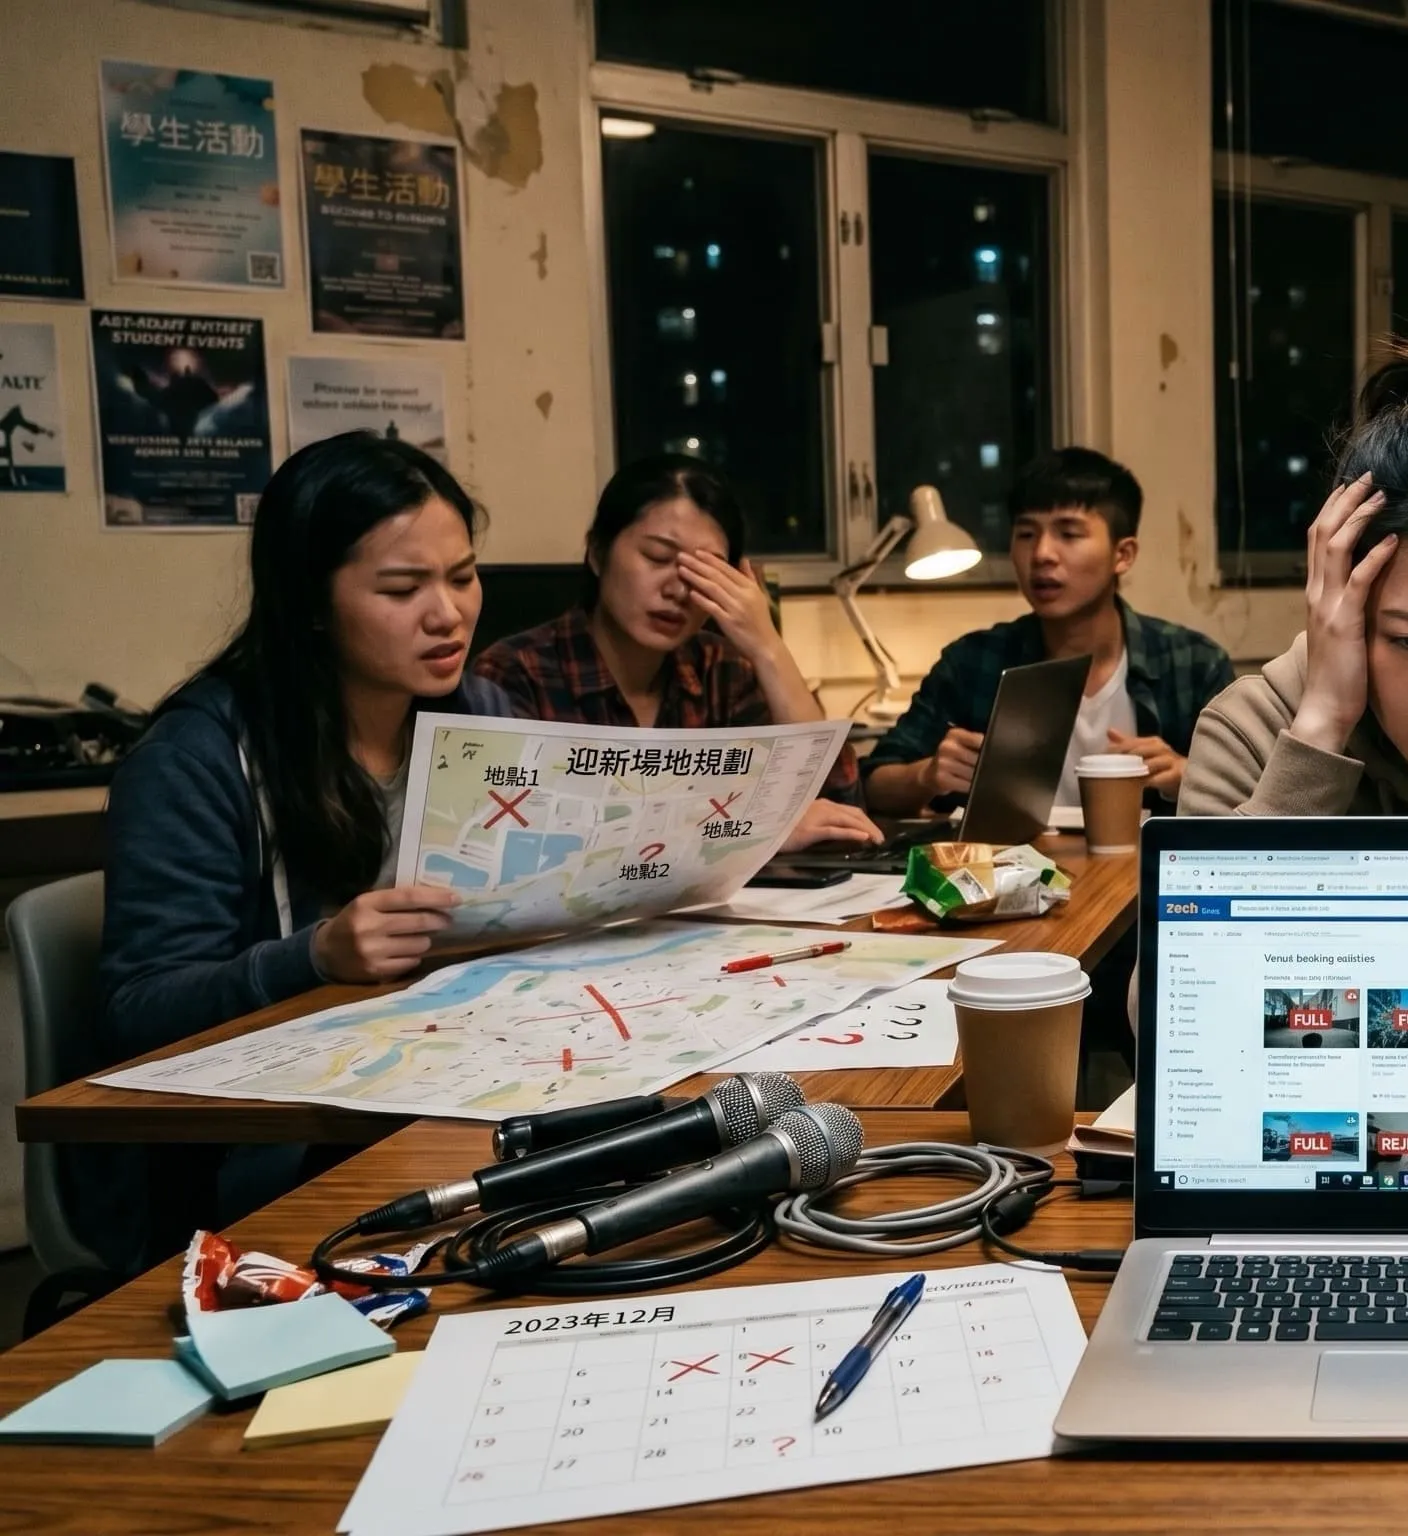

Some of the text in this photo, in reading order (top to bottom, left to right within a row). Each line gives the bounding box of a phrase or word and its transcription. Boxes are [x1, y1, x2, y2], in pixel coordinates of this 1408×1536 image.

[120, 111, 264, 159] 學生活動
[314, 163, 450, 210] 學生活動
[112, 331, 245, 350] STUDENT EVENTS
[484, 765, 540, 787] 地點1
[565, 747, 754, 777] 迎新場地規劃
[703, 820, 752, 839] 地點2
[619, 862, 670, 881] 地點2
[1294, 1014, 1328, 1026] FULL
[1294, 1137, 1328, 1150] FULL
[503, 1305, 676, 1335] 2023年12月
[485, 1407, 504, 1415] 12
[571, 1398, 591, 1406] 13
[655, 1388, 673, 1396] 14
[739, 1379, 757, 1387] 15
[898, 1359, 914, 1367] 17
[474, 1375, 1002, 1447] 19 20 21 22 24 25
[552, 1459, 577, 1470] 27
[733, 1437, 755, 1447] 29
